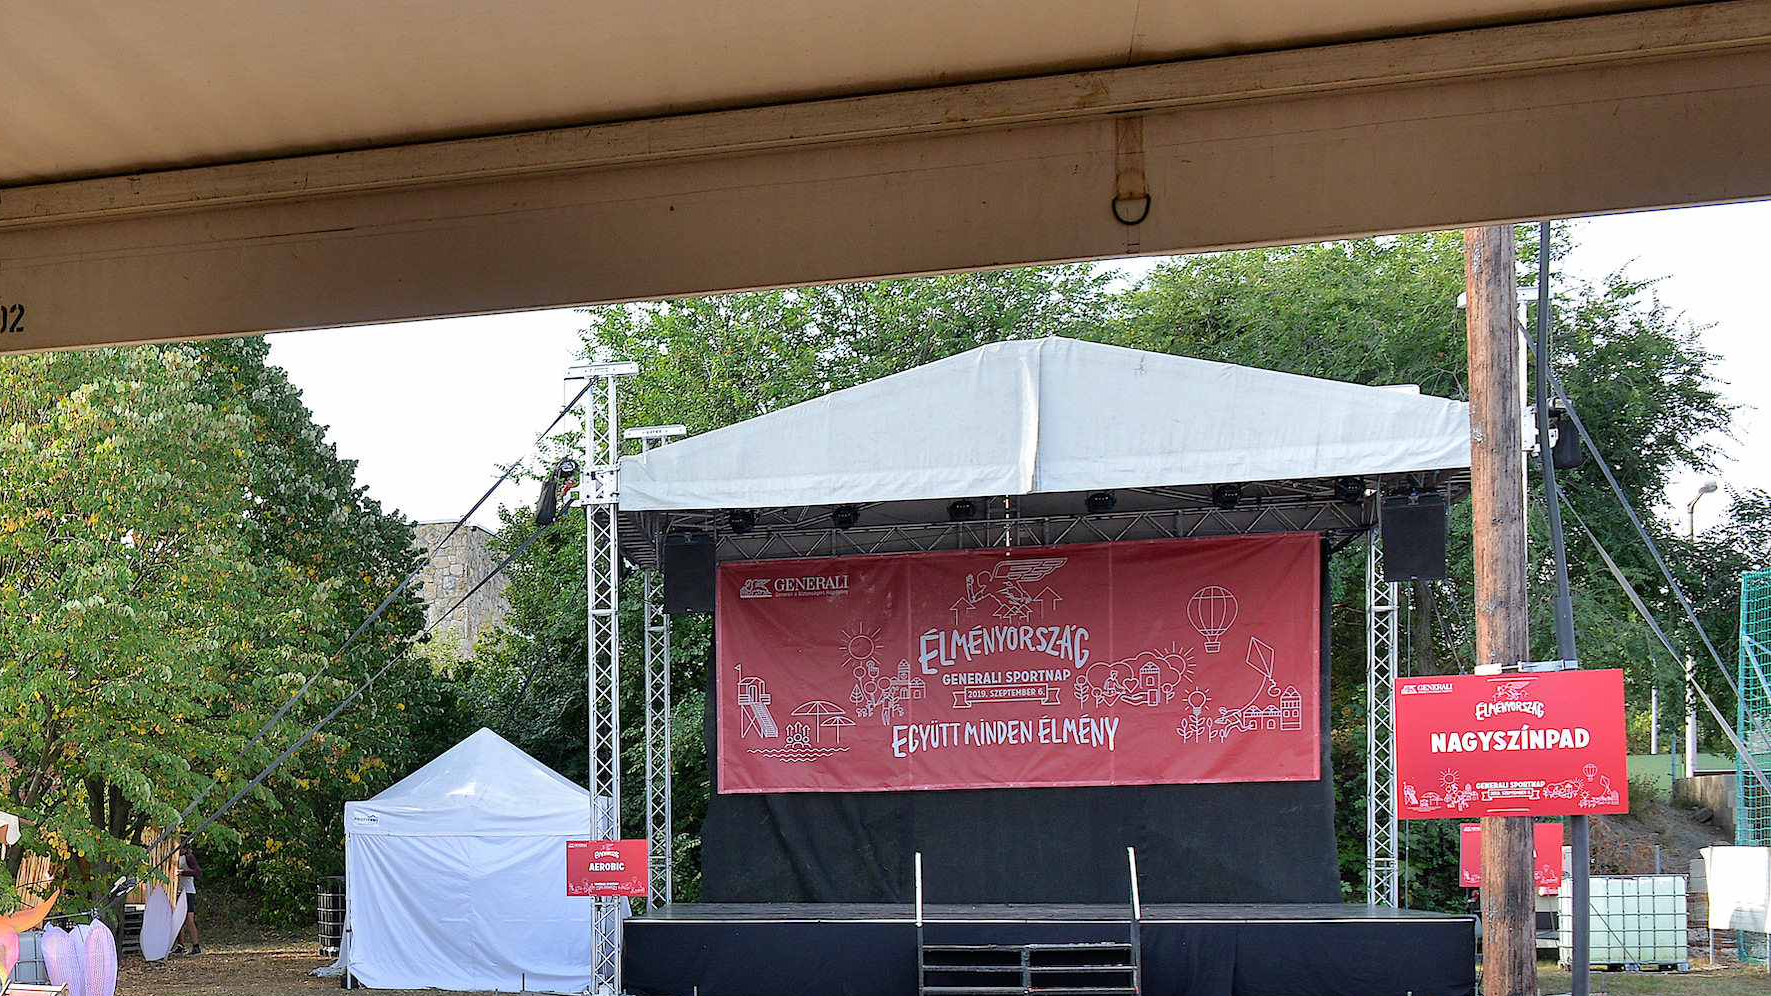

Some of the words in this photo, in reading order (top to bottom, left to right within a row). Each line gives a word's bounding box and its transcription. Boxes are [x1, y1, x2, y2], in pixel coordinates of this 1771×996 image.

[774, 575, 849, 592] GENERALI
[918, 624, 1090, 675] ÉLMÉNYORSZÁG
[942, 671, 1002, 686] GENERALI
[1005, 668, 1071, 683] SPORTNAP
[967, 690, 989, 699] 2019.
[989, 688, 1038, 699] SZEPTEMBER
[1037, 688, 1046, 697] 6.
[891, 720, 961, 758] EGYÜTT
[1037, 713, 1120, 751] ÉLMÉNY
[1430, 724, 1591, 754] NAGYSZÍNPAD
[1475, 781, 1509, 790] GENERALI
[1509, 780, 1546, 788] SPORTNAP
[588, 861, 626, 872] AEROBIC
